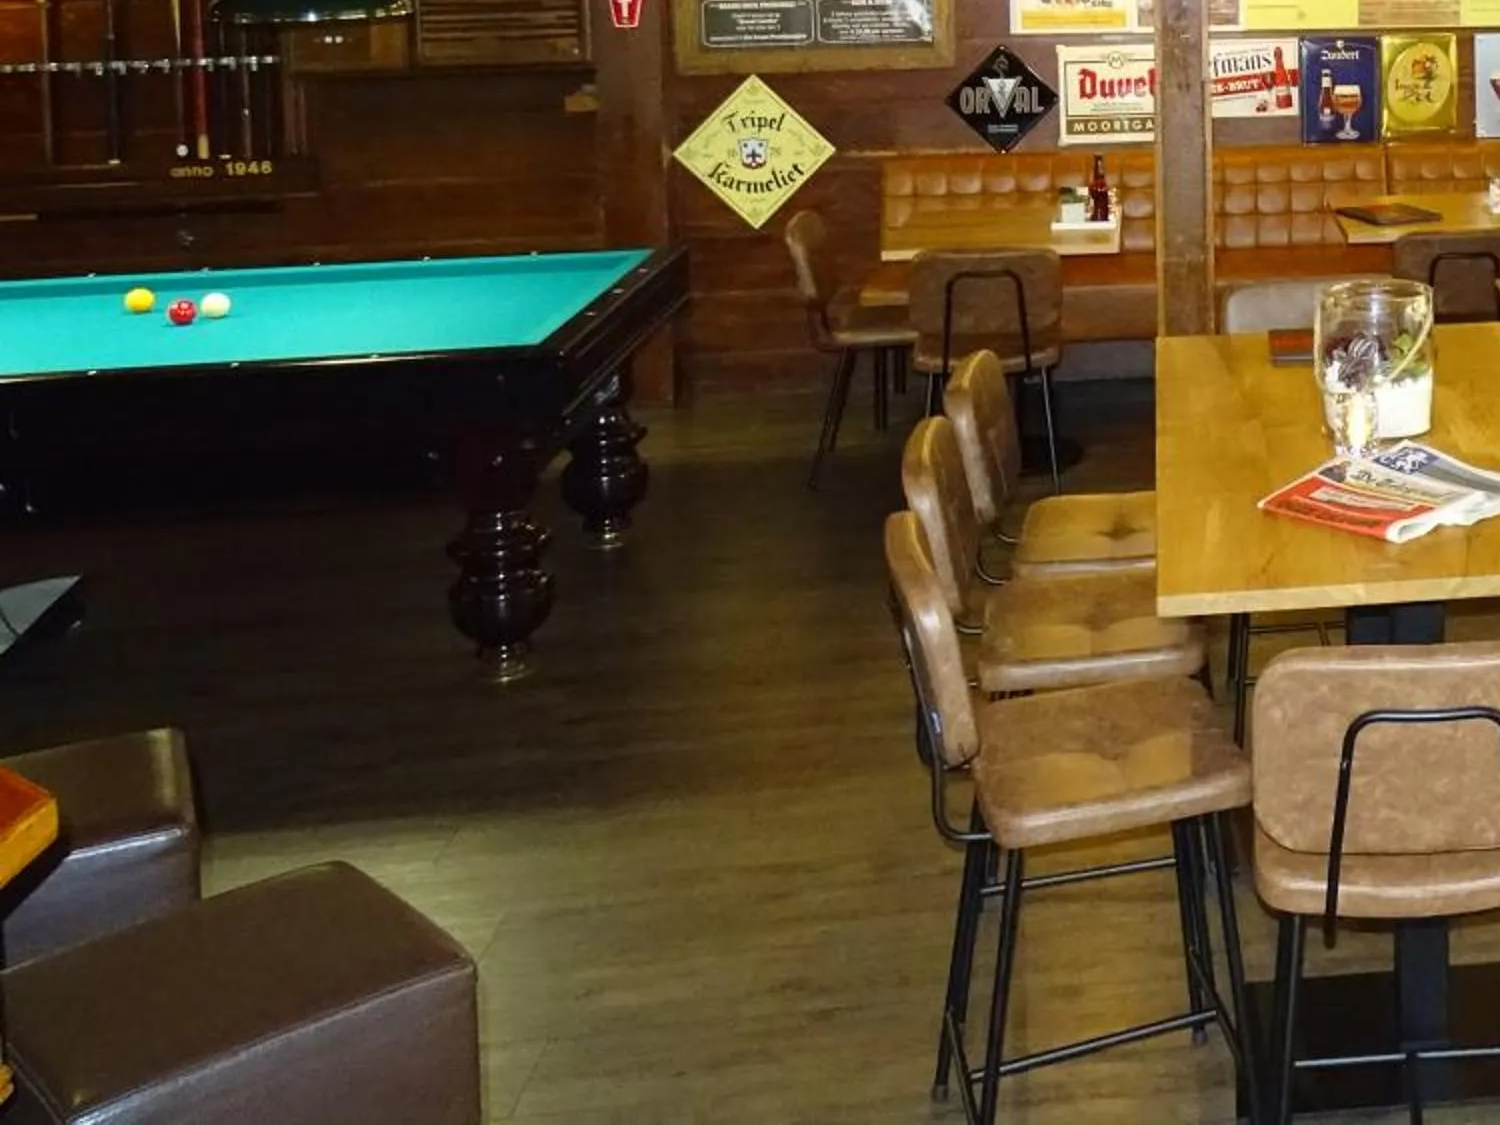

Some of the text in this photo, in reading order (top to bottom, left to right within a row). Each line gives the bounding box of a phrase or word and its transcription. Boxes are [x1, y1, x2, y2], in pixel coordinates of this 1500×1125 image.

[959, 76, 1045, 118] ORVAL
[1078, 68, 1156, 100] Duvel
[722, 111, 785, 133] Tripel
[1072, 119, 1155, 132] MOORTGA
[708, 162, 805, 194] Karmeliet
